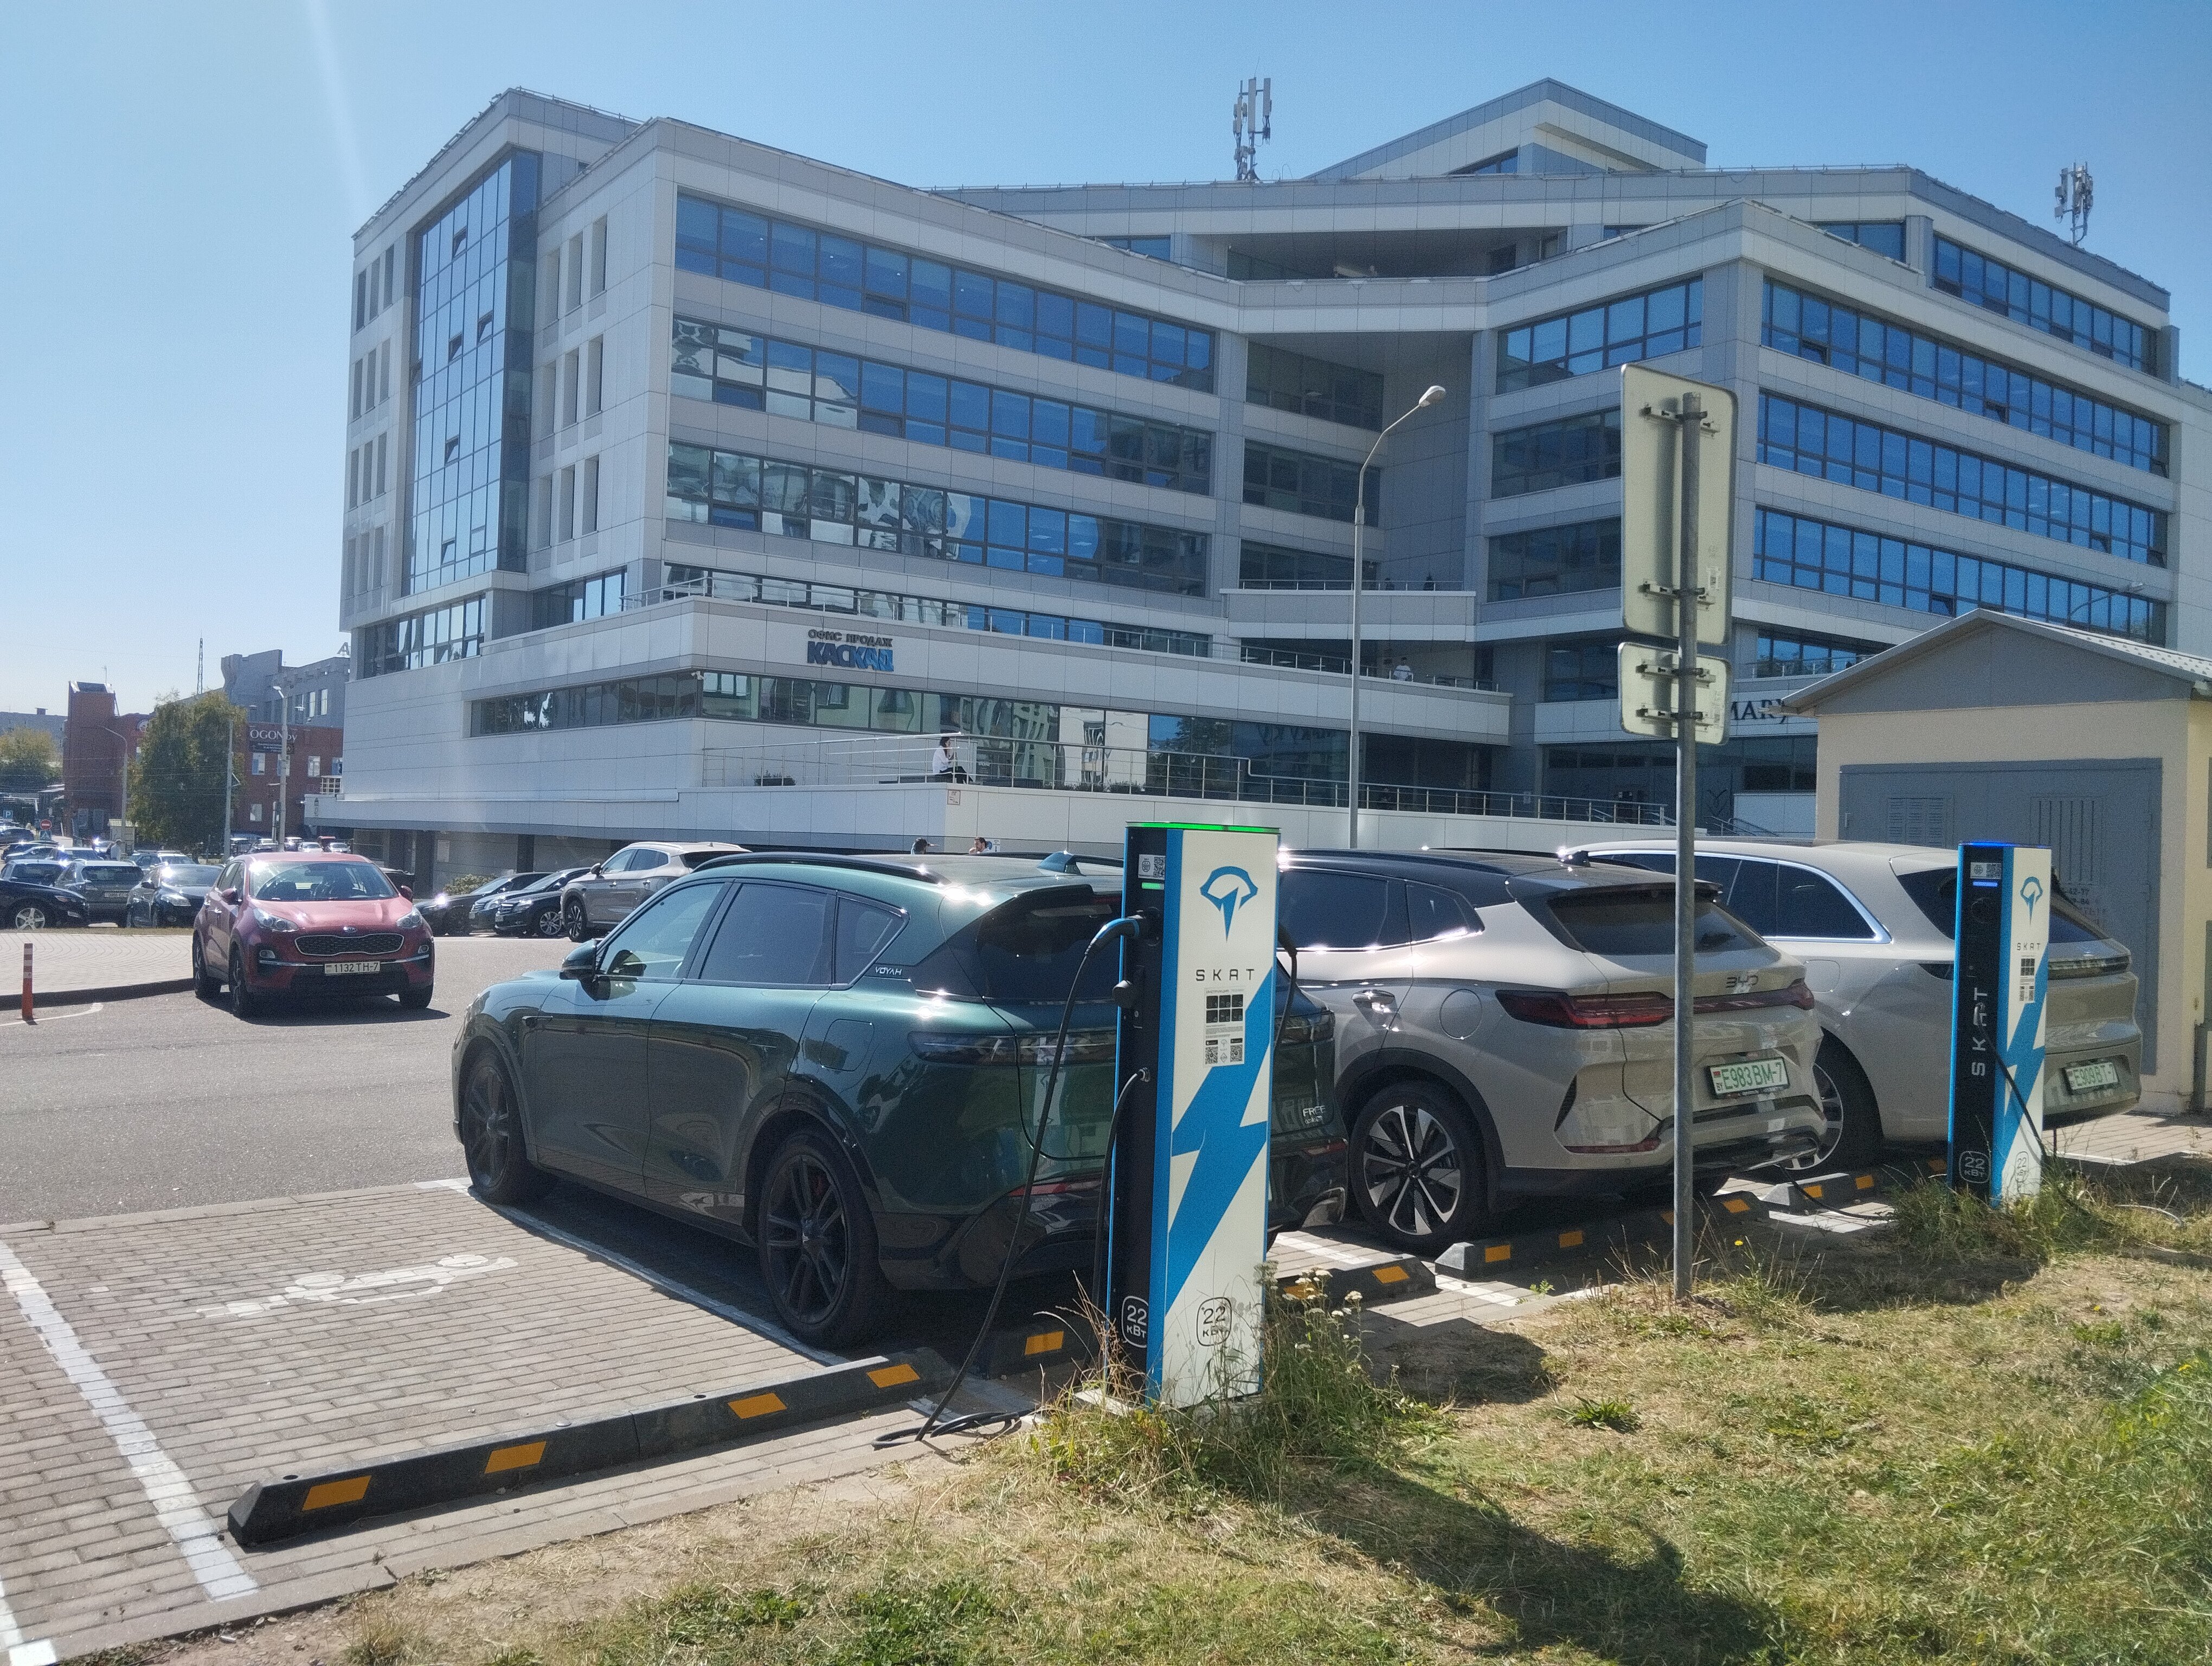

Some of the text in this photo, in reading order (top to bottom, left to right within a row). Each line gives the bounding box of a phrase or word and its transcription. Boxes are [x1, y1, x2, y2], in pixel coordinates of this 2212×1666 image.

[808, 629, 893, 647] ОФИС ПРОДАЖ
[807, 641, 894, 672] КАСКАД
[2017, 943, 2041, 951] SKAT
[875, 966, 902, 976] VOYAH
[1196, 969, 1255, 981] SKAT
[1965, 1157, 1985, 1169] 22
[2017, 1157, 2027, 1169] 22
[1127, 1305, 1147, 1327] 22
[1203, 1306, 1226, 1324] 22
